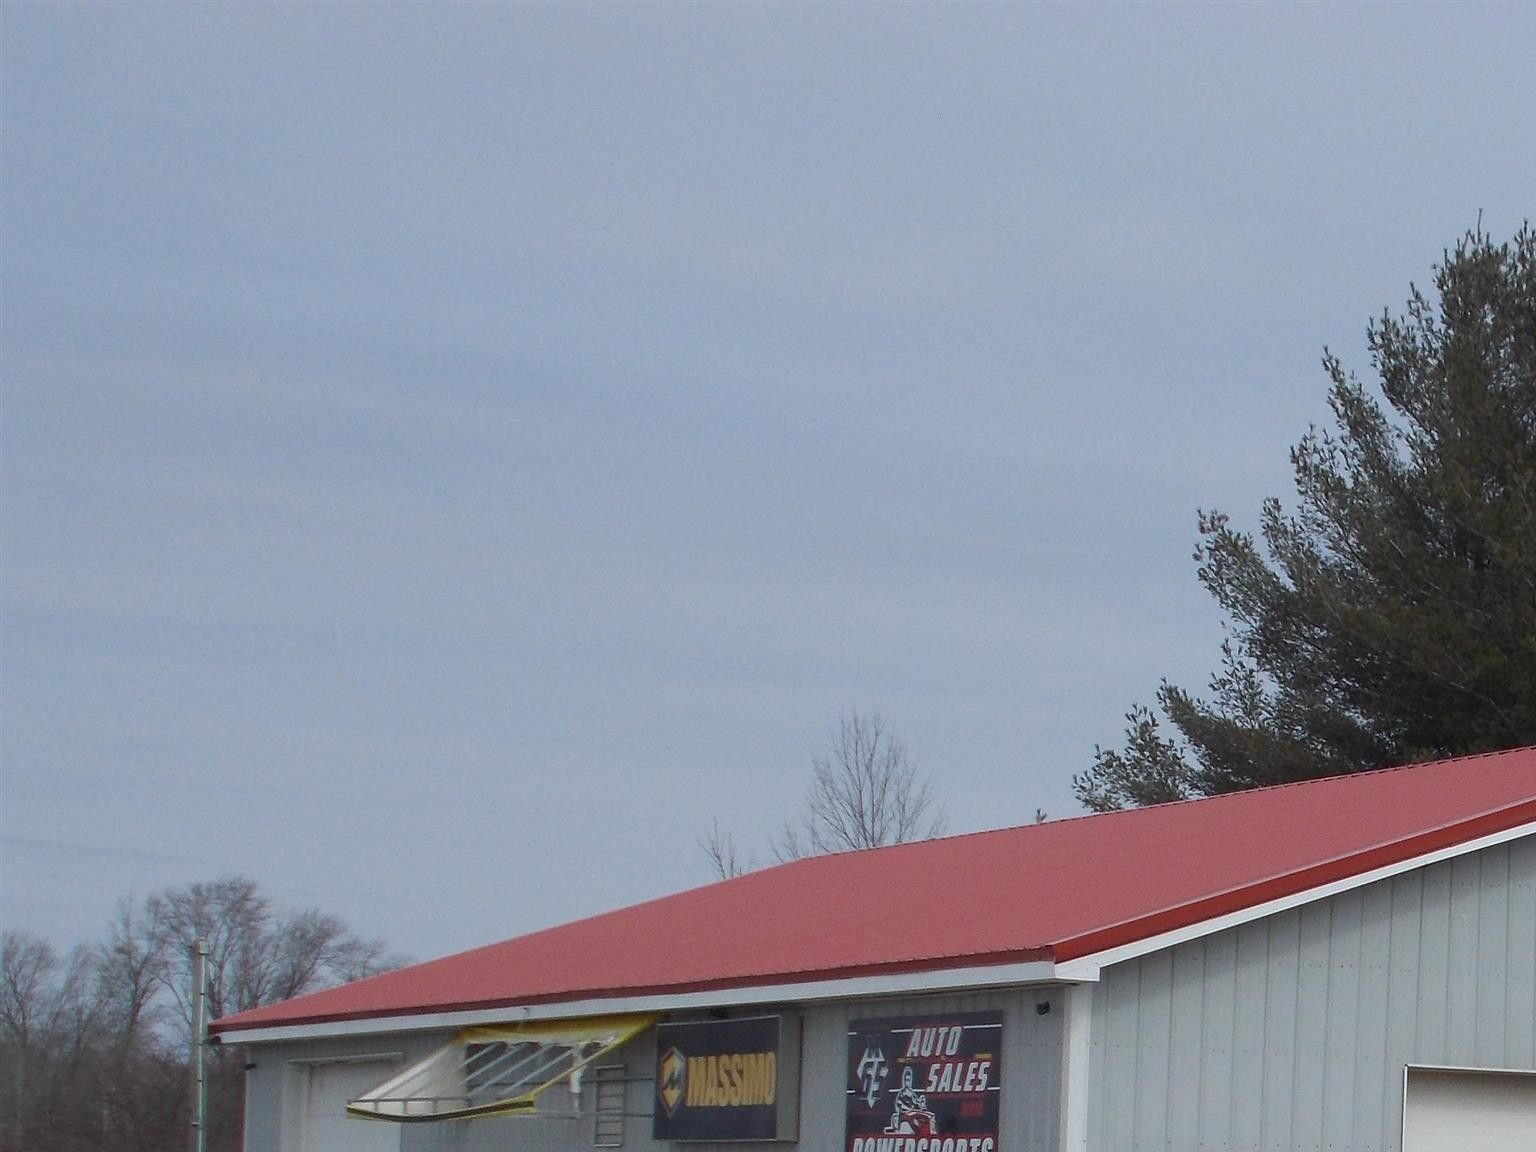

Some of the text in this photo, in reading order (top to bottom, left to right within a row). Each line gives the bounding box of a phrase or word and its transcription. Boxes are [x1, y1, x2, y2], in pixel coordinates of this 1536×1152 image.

[906, 1026, 962, 1057] AUTO
[686, 1052, 776, 1107] MASSIMO
[925, 1062, 991, 1092] SALES
